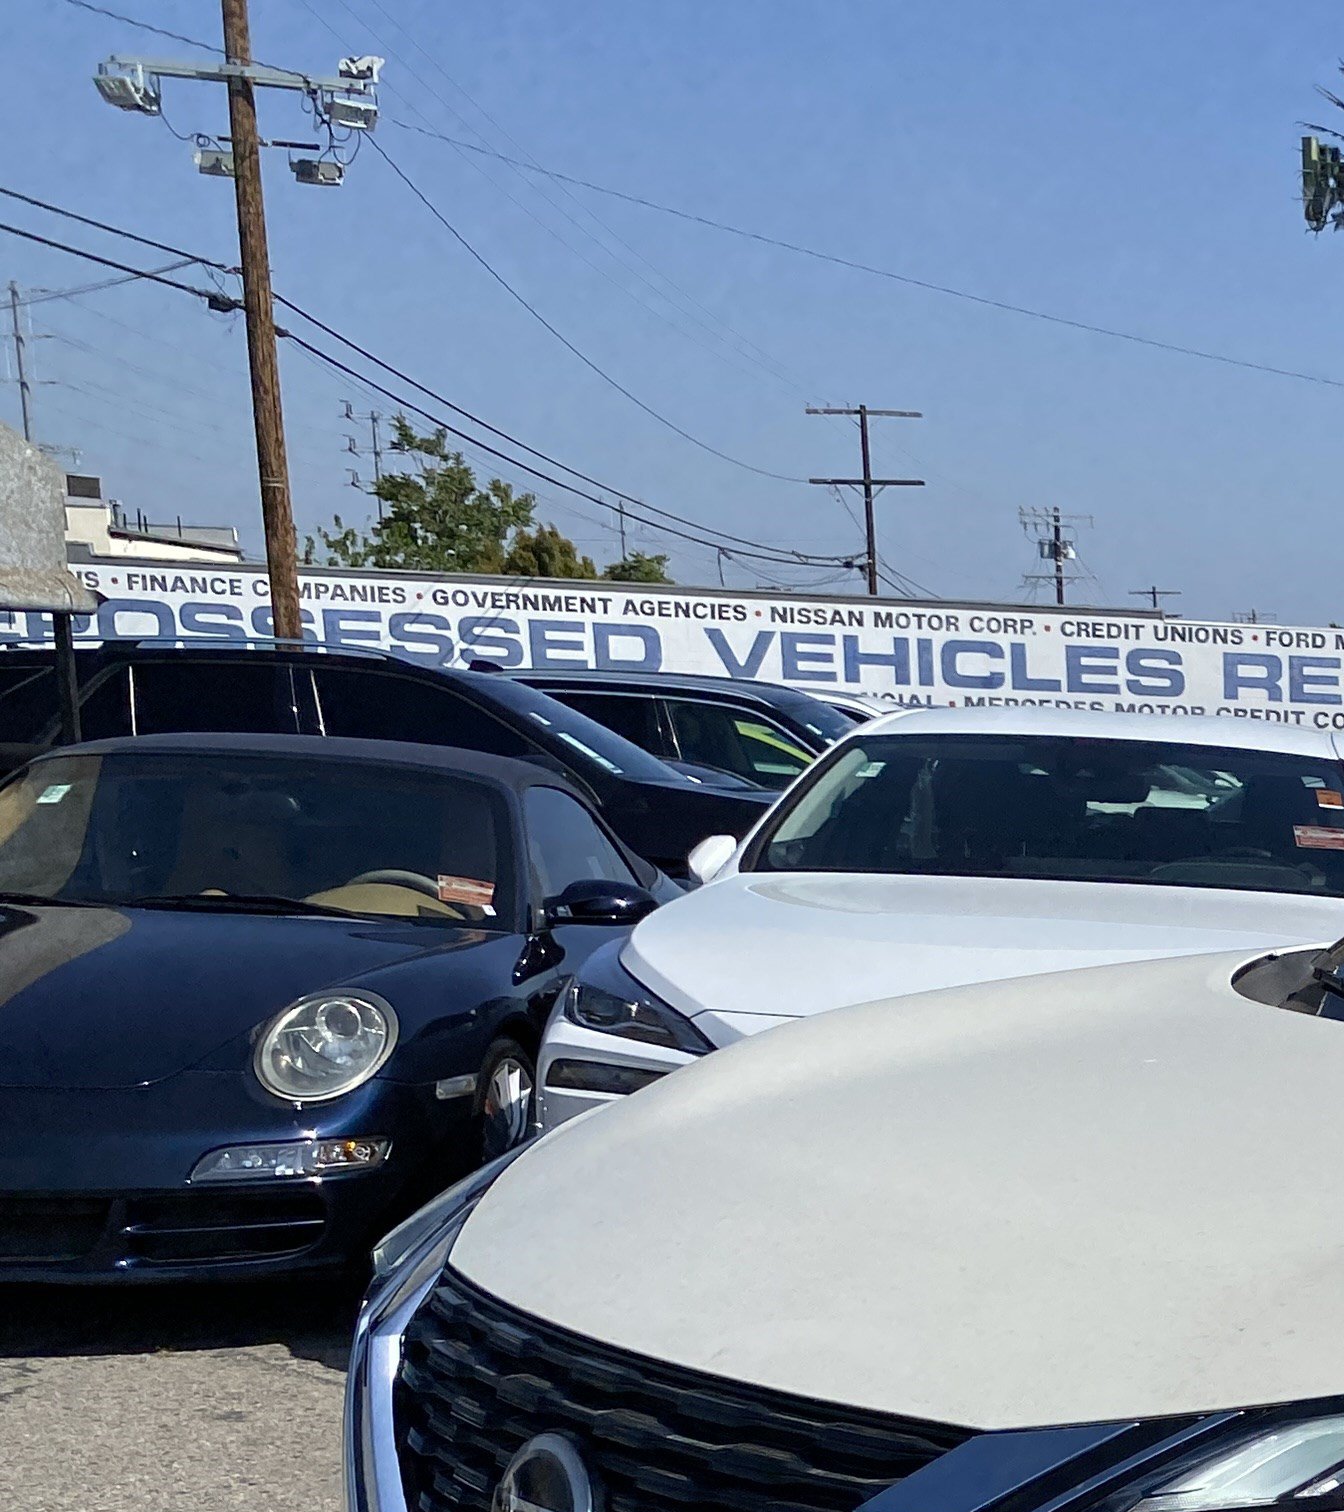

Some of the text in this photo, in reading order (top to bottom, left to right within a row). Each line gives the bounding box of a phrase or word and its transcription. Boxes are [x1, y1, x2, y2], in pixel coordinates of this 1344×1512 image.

[127, 573, 243, 597] FINANCE
[252, 579, 406, 604] CMPANIES
[432, 588, 612, 616] GOVERNMENT
[622, 598, 748, 622] AGENCIES
[770, 606, 864, 628] NISSAN
[873, 611, 960, 633] MOTOR
[969, 616, 1037, 636] CORP.
[1060, 620, 1145, 641] CREDIT
[1153, 625, 1244, 645] UNIONS
[1265, 630, 1326, 649] FORD
[703, 627, 1186, 698] VEHICLES
